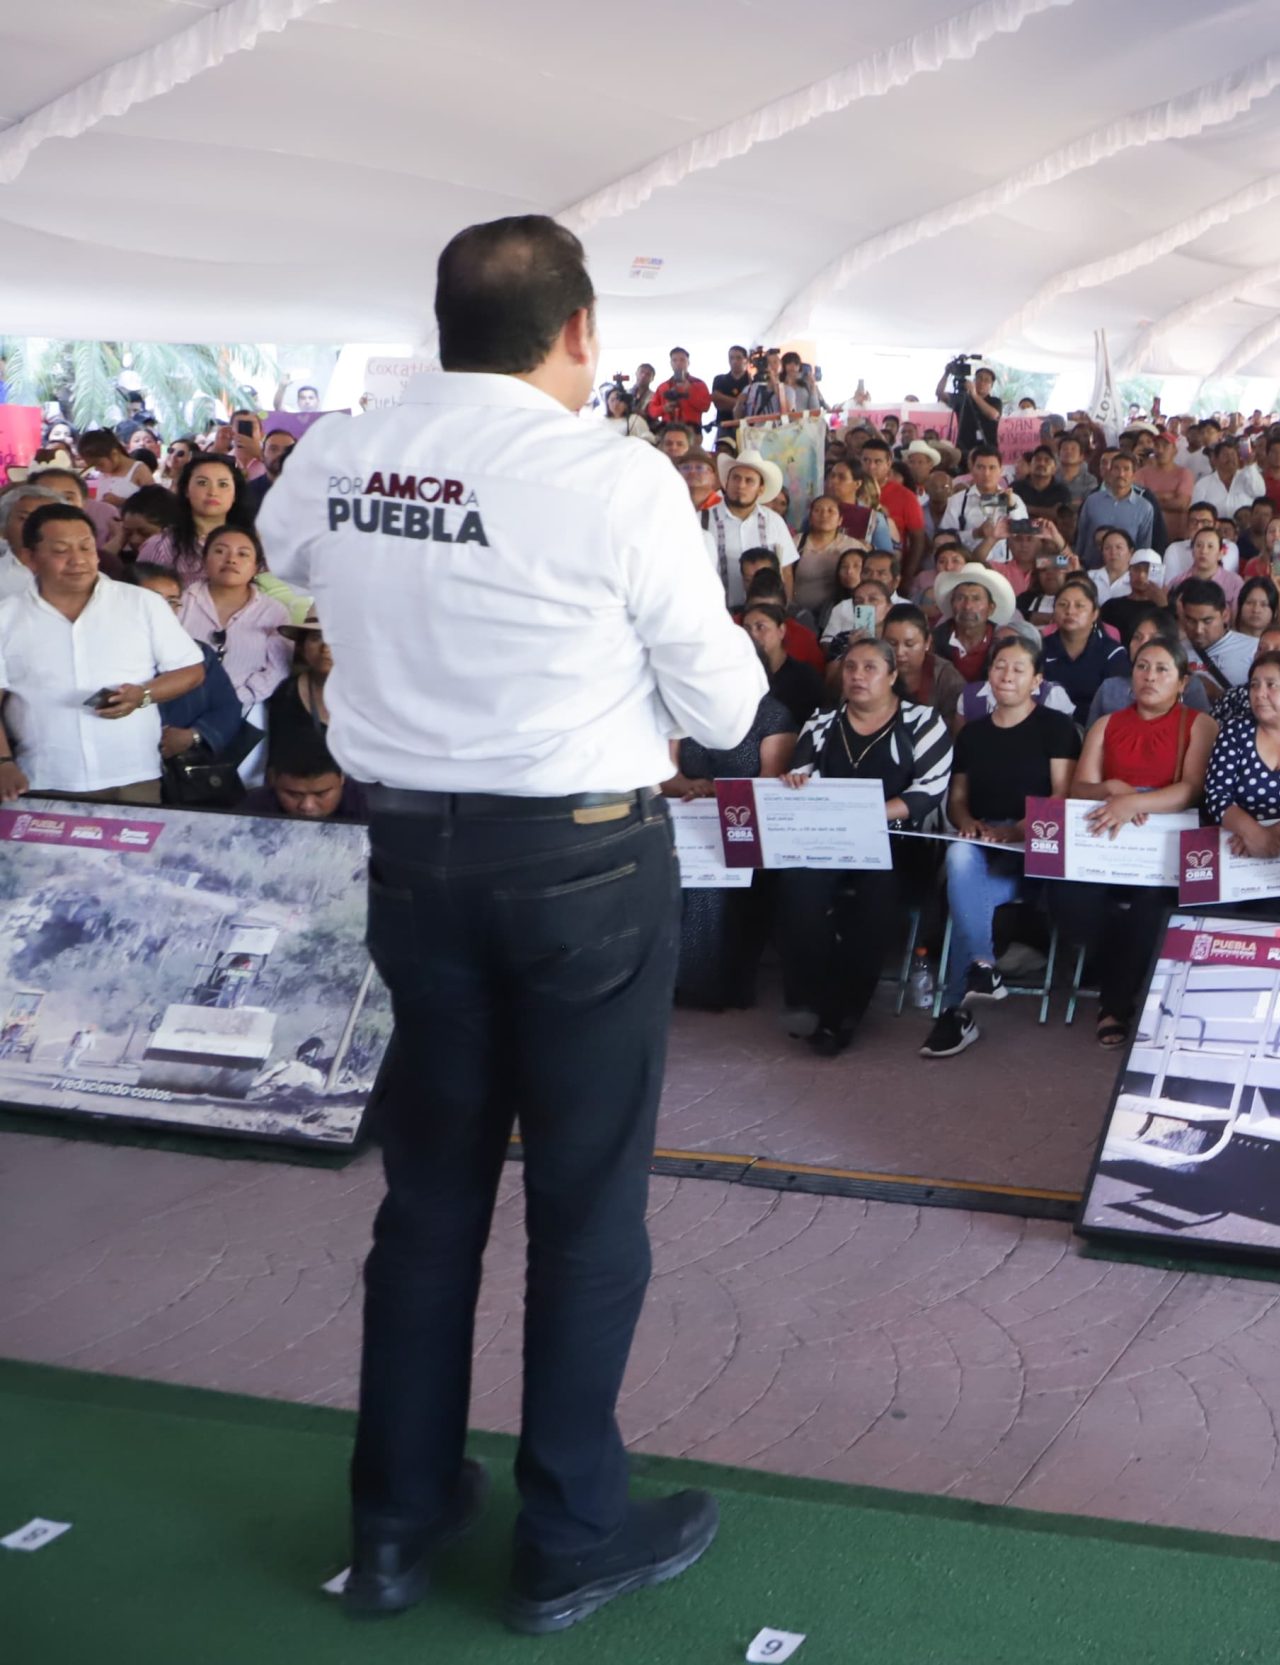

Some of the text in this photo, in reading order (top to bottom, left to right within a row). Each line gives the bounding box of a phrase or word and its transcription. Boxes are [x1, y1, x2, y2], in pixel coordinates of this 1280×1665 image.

[328, 472, 479, 506] POR AMOR A
[328, 497, 490, 547] PUEBLA
[727, 831, 754, 839] OBRA
[1031, 842, 1059, 850] OBRA
[1185, 870, 1213, 879] OBRA
[1211, 939, 1257, 951] PUEBLA
[62, 1079, 130, 1096] reduciendo
[131, 1087, 173, 1101] costos.
